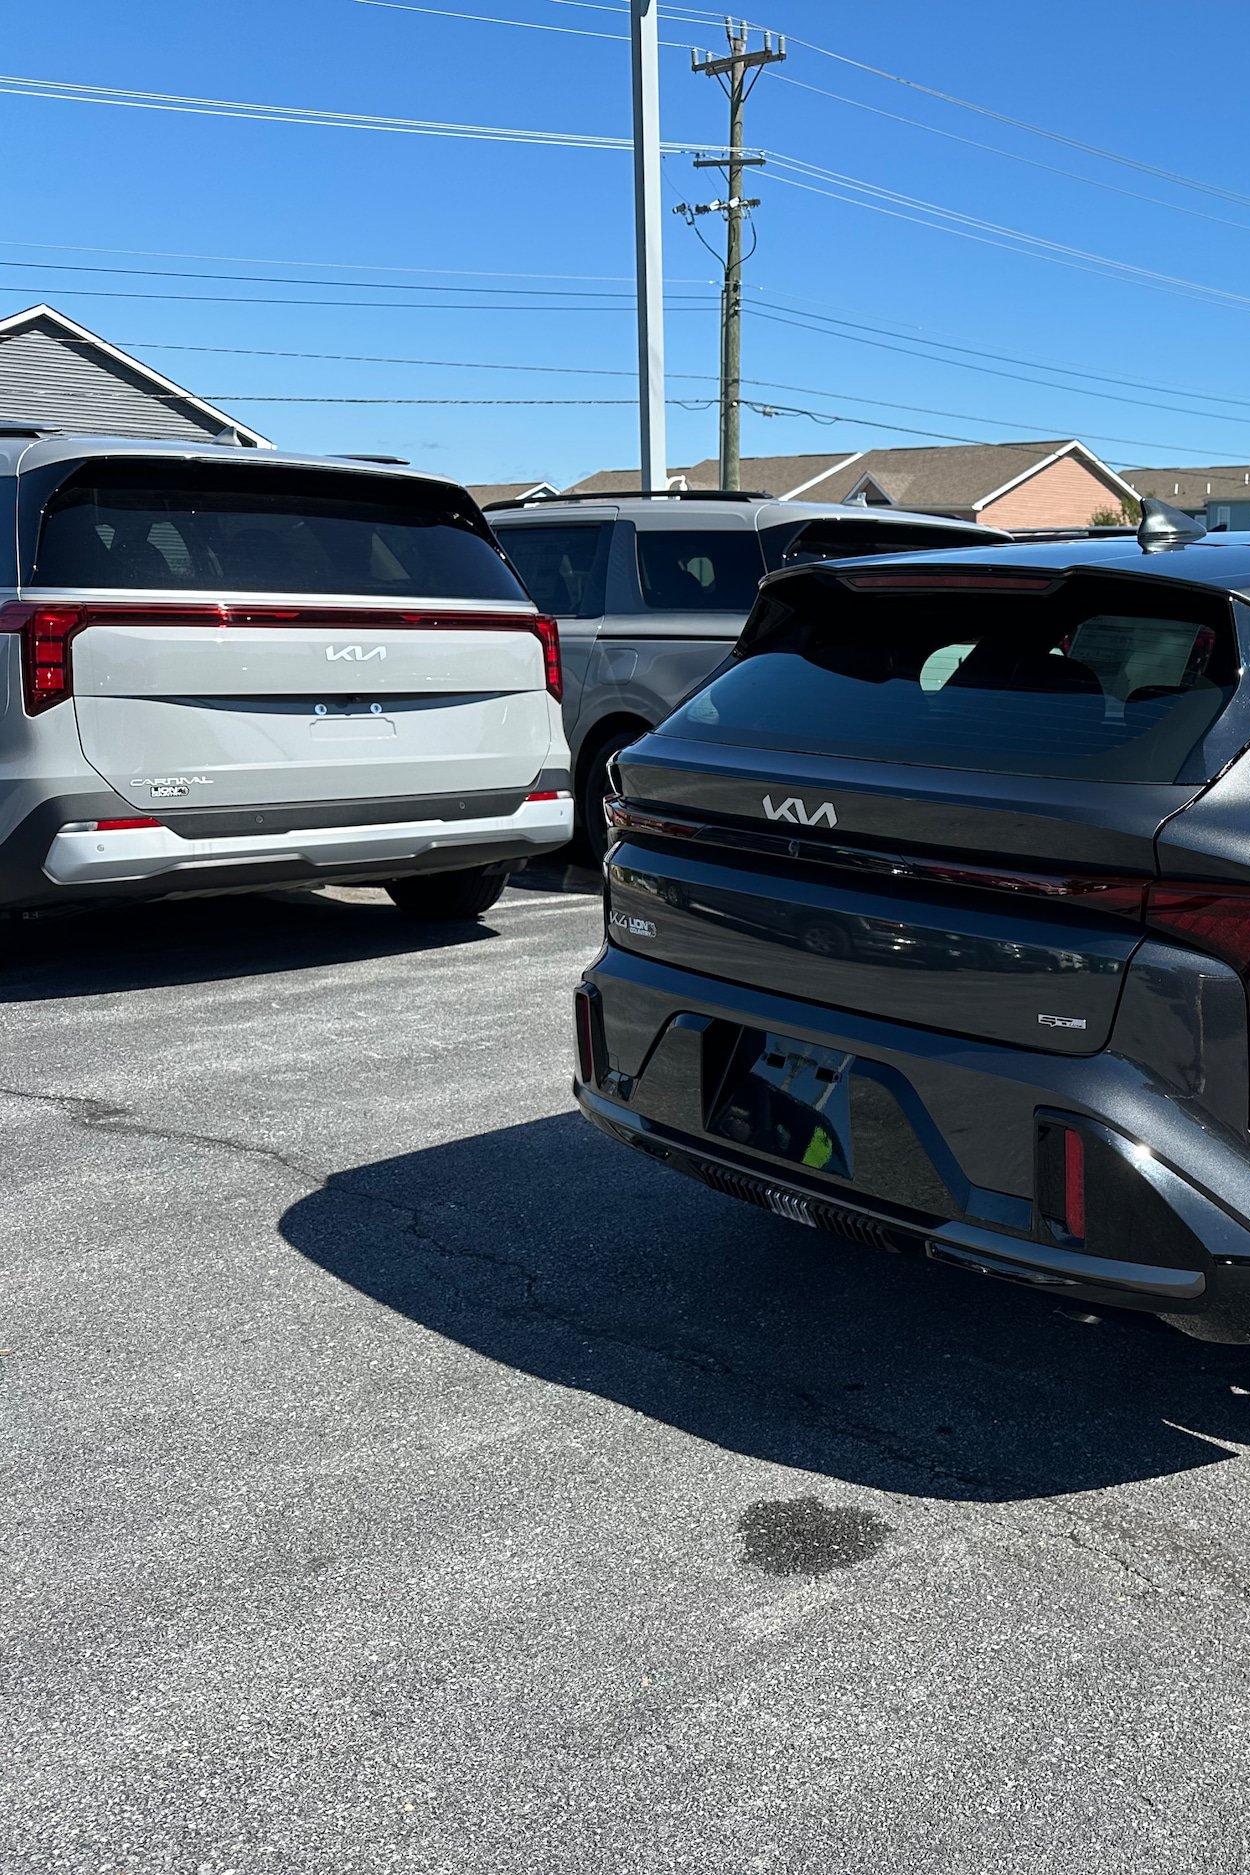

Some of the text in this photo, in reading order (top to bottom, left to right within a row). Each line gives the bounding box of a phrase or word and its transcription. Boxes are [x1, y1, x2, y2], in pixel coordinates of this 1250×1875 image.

[129, 776, 214, 787] CARNIVAL
[609, 911, 628, 929] K4
[629, 917, 649, 931] LION
